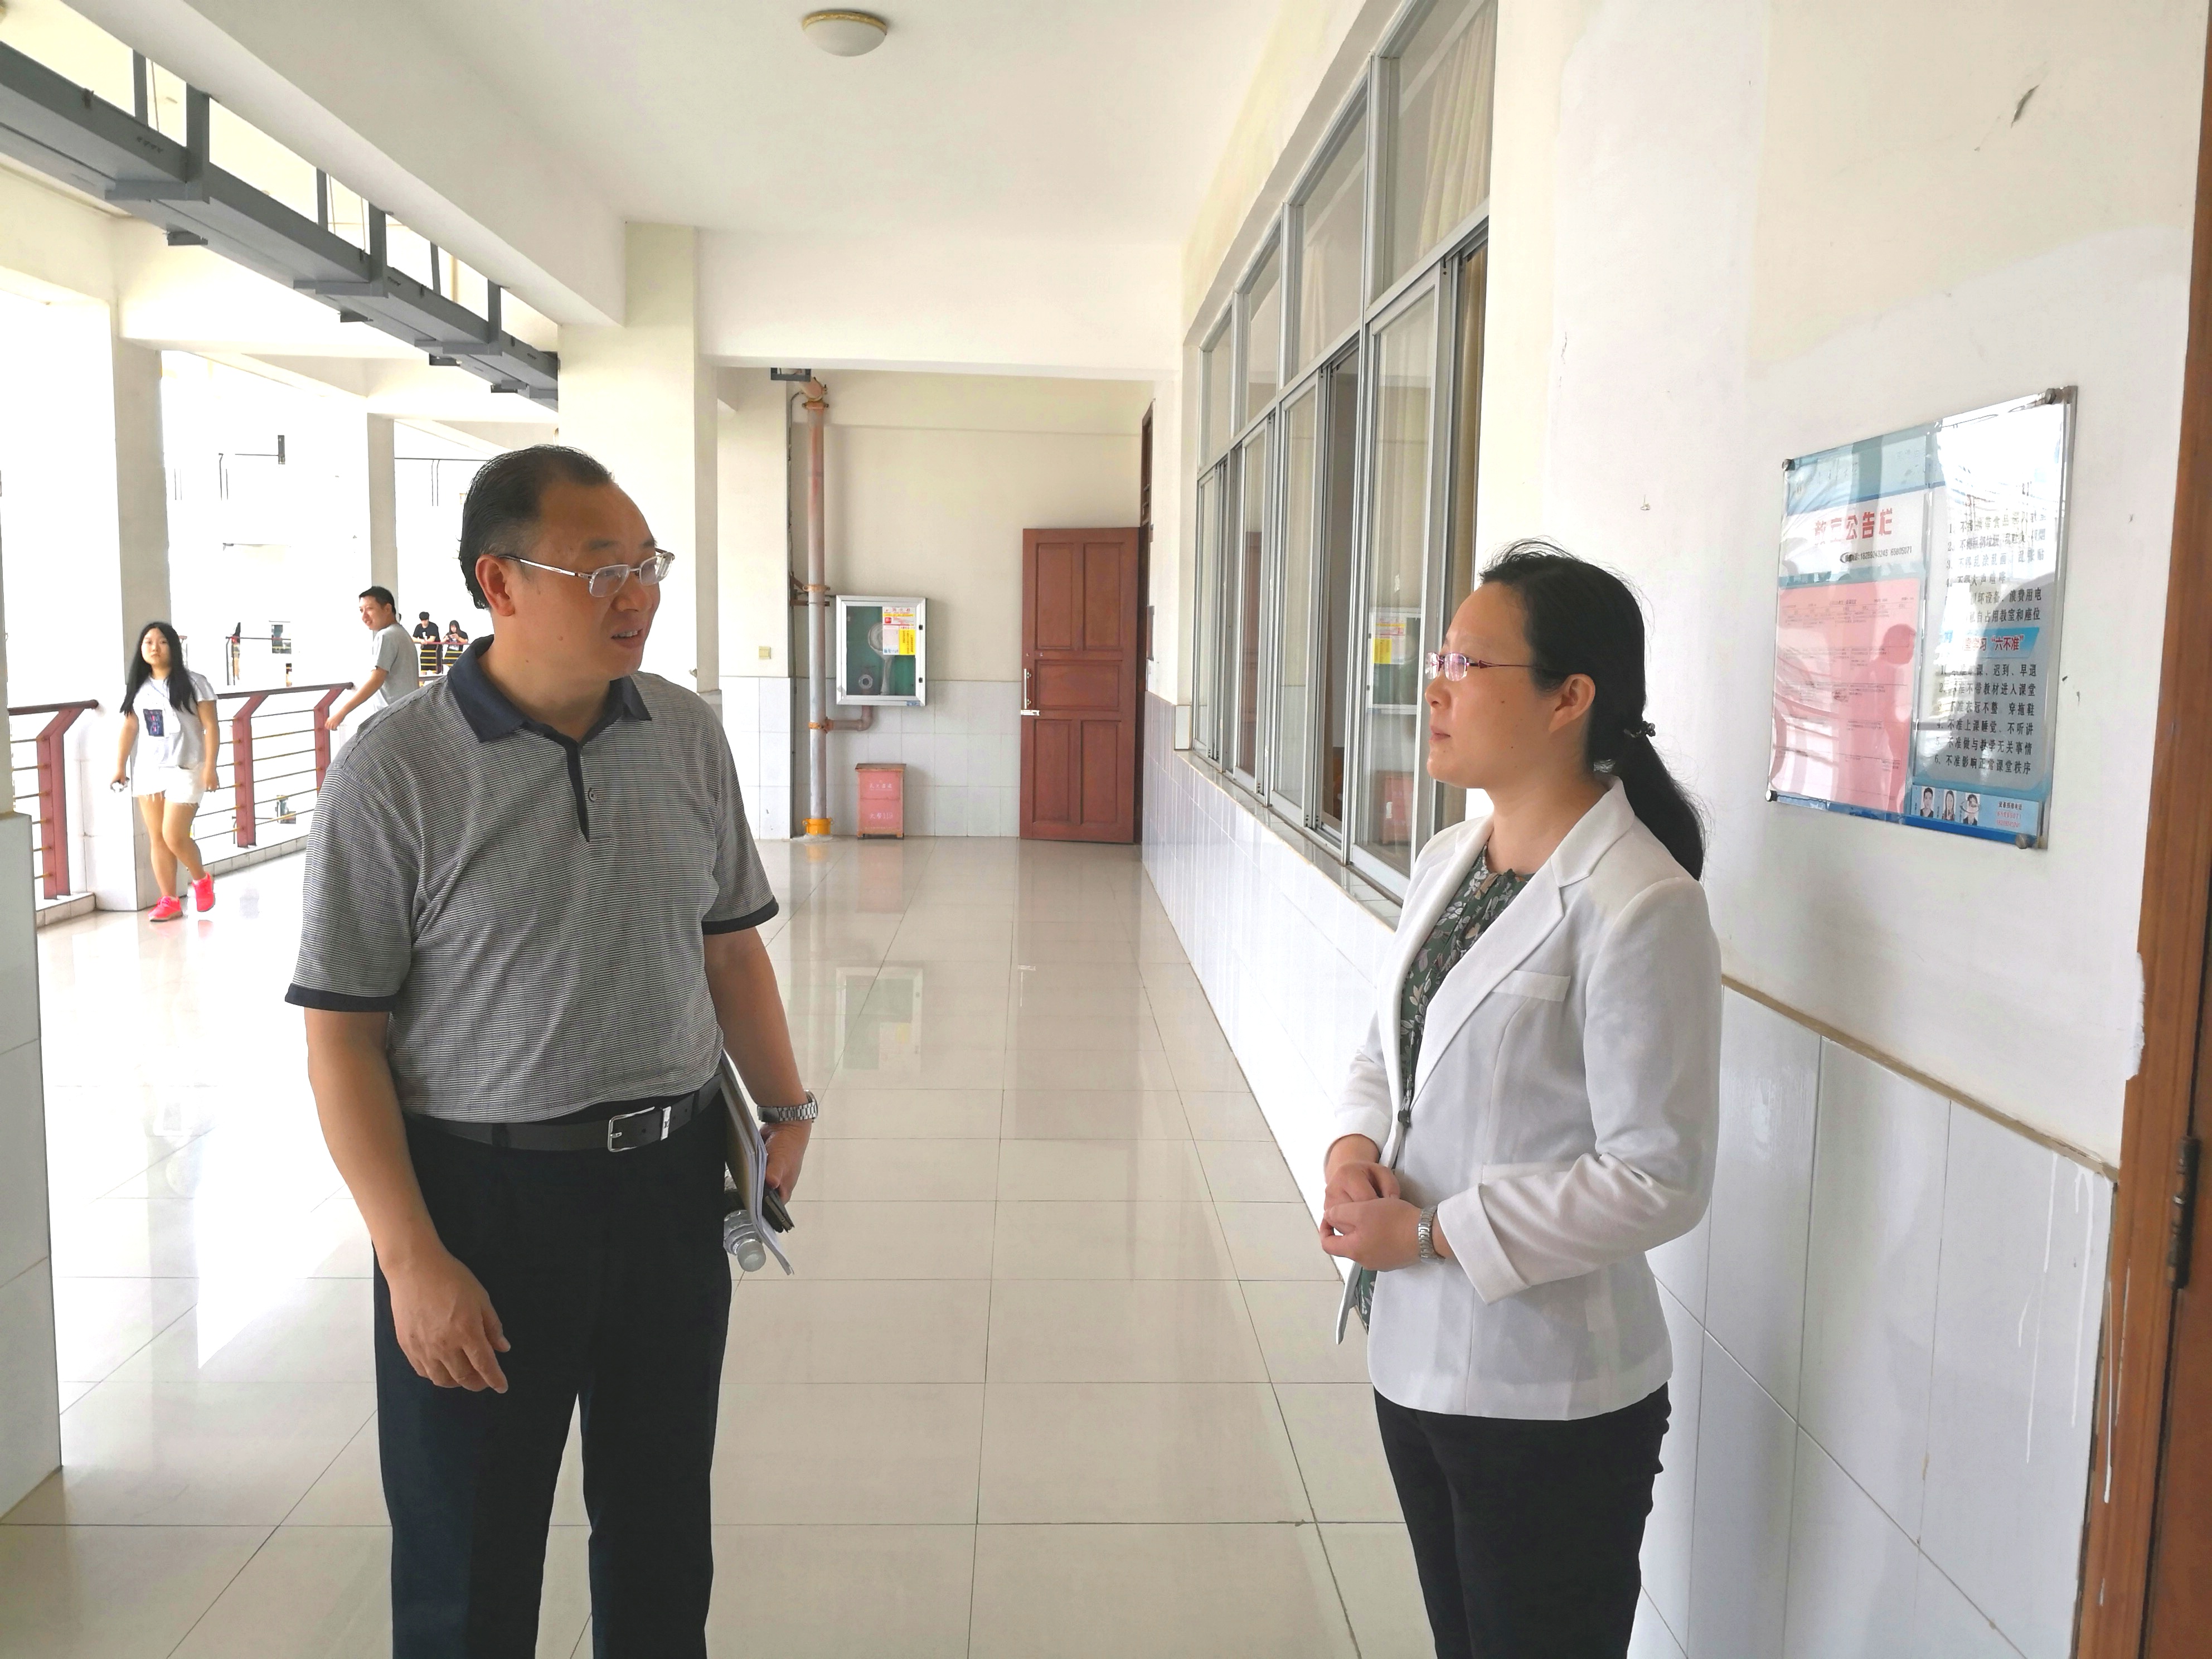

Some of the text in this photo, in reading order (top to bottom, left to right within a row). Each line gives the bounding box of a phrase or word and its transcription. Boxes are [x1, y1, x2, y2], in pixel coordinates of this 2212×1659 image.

[1956, 634, 2024, 651] 堂学习“六不准”
